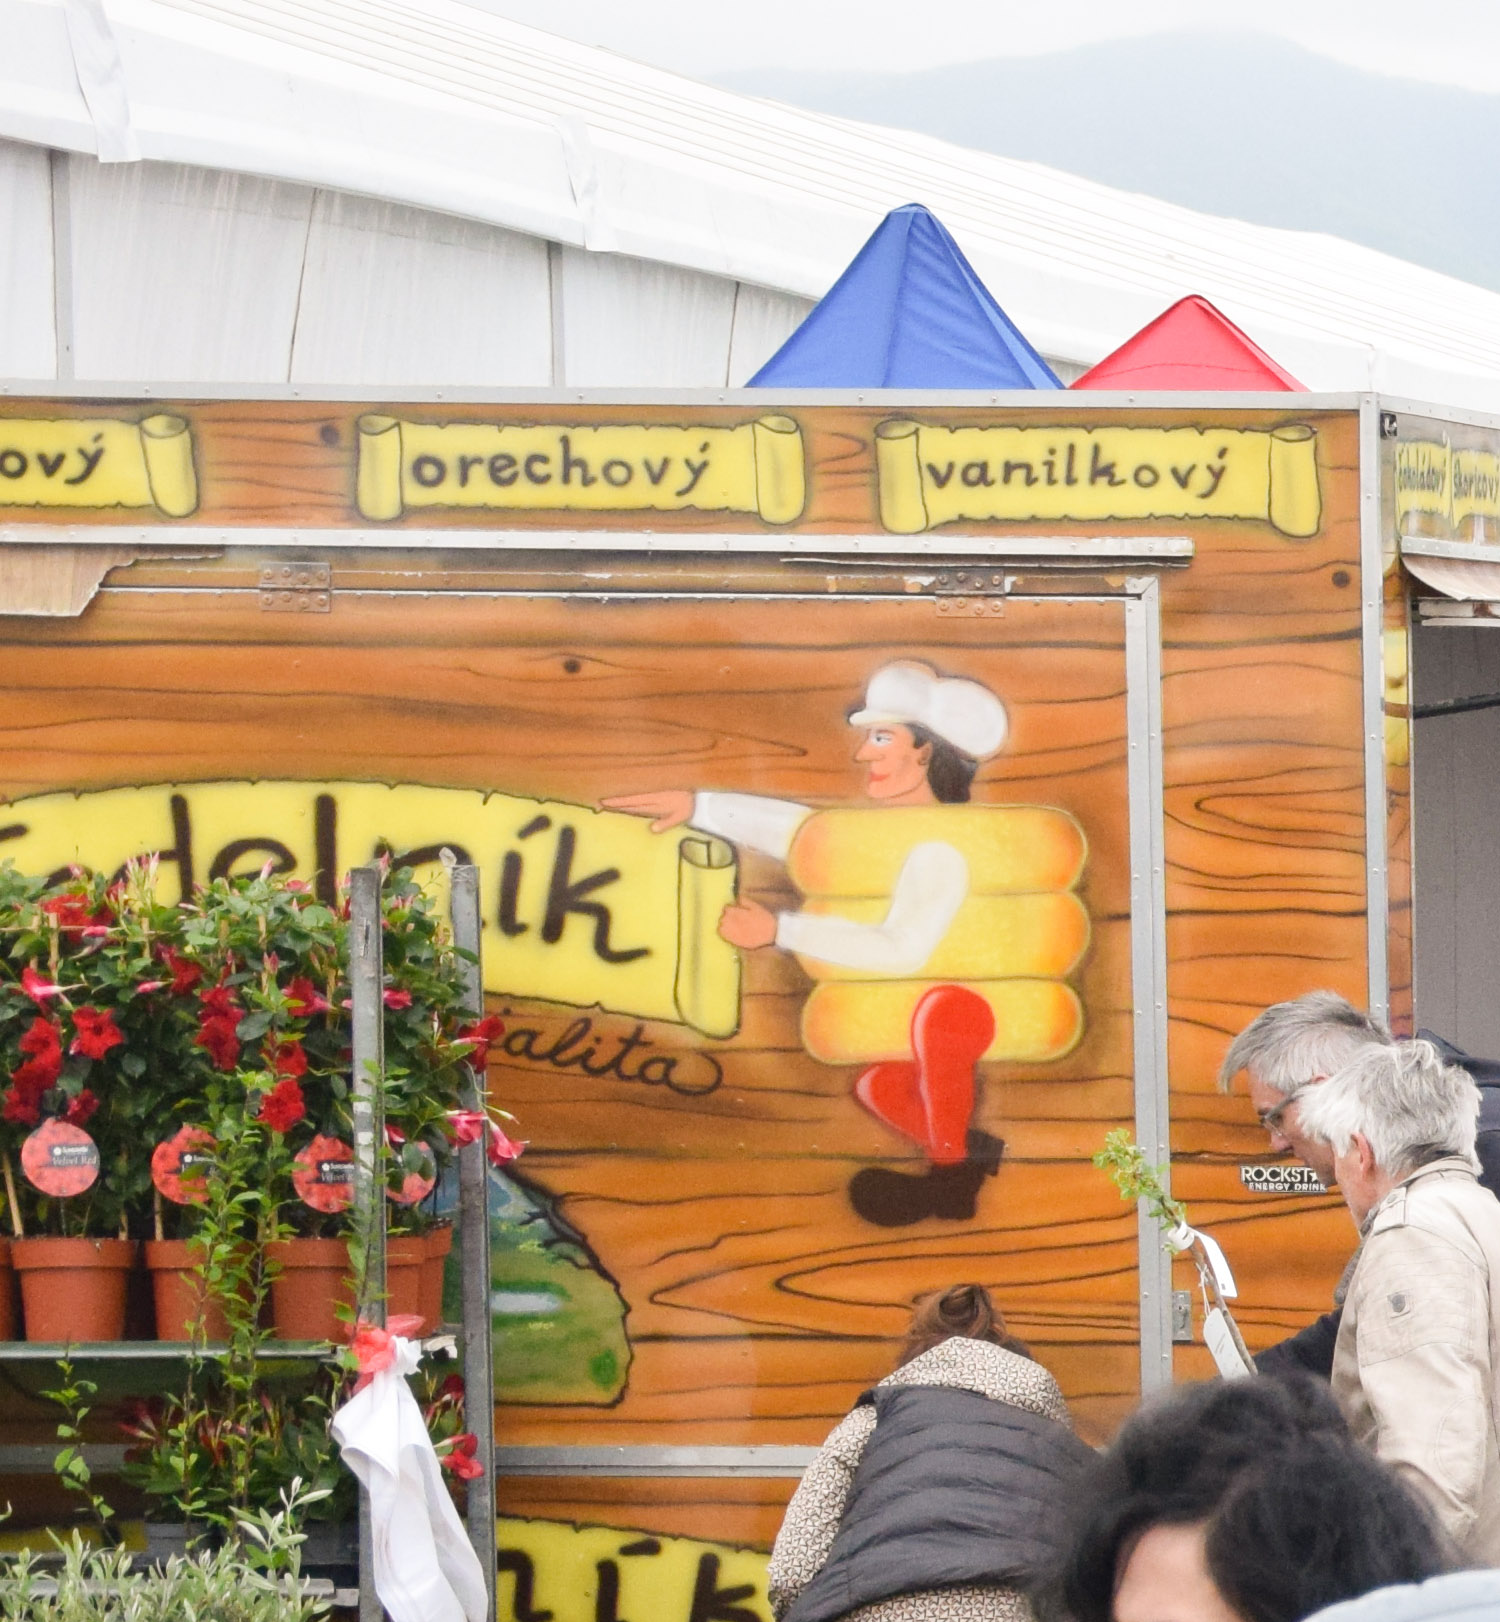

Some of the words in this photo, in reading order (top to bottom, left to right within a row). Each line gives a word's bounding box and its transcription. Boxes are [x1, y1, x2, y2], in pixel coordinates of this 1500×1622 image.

[411, 435, 712, 496] orechový
[926, 442, 1229, 499] vanilkový
[1294, 1182, 1327, 1192] DRINK
